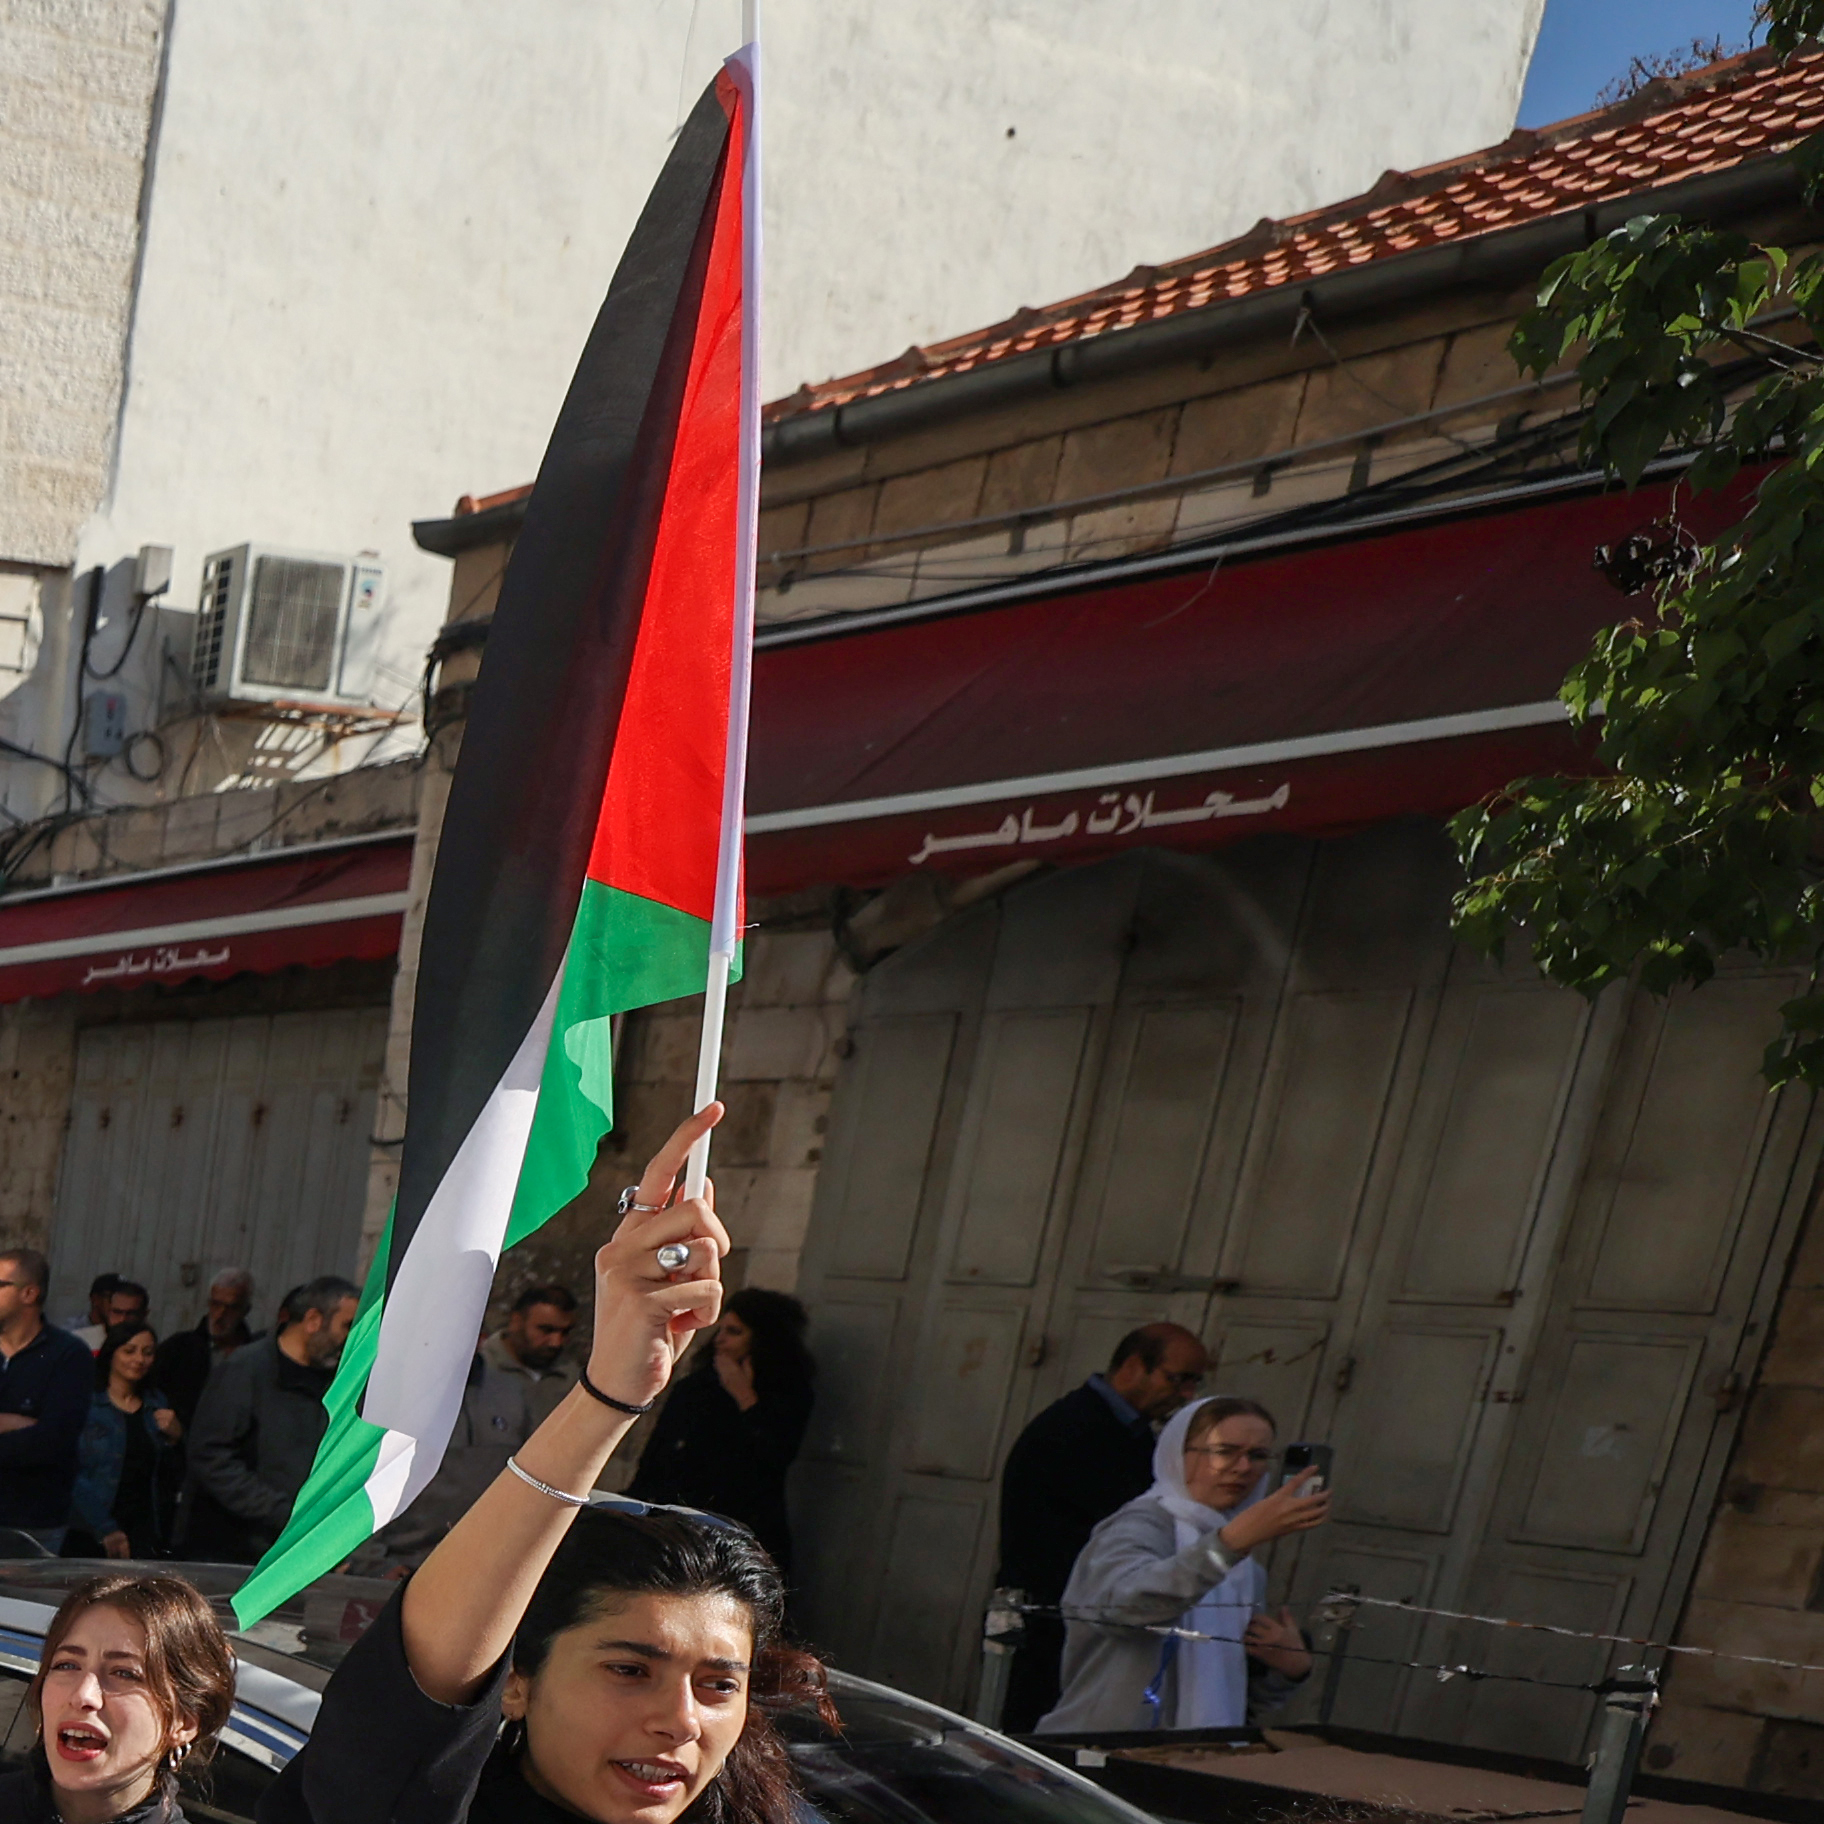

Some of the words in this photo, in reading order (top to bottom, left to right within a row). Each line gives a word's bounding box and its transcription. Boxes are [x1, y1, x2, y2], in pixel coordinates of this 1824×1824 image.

[1086, 779, 1292, 834] محلات
[908, 811, 1080, 865] ماهر
[81, 952, 151, 985] ماهر
[153, 946, 231, 972] محلات
